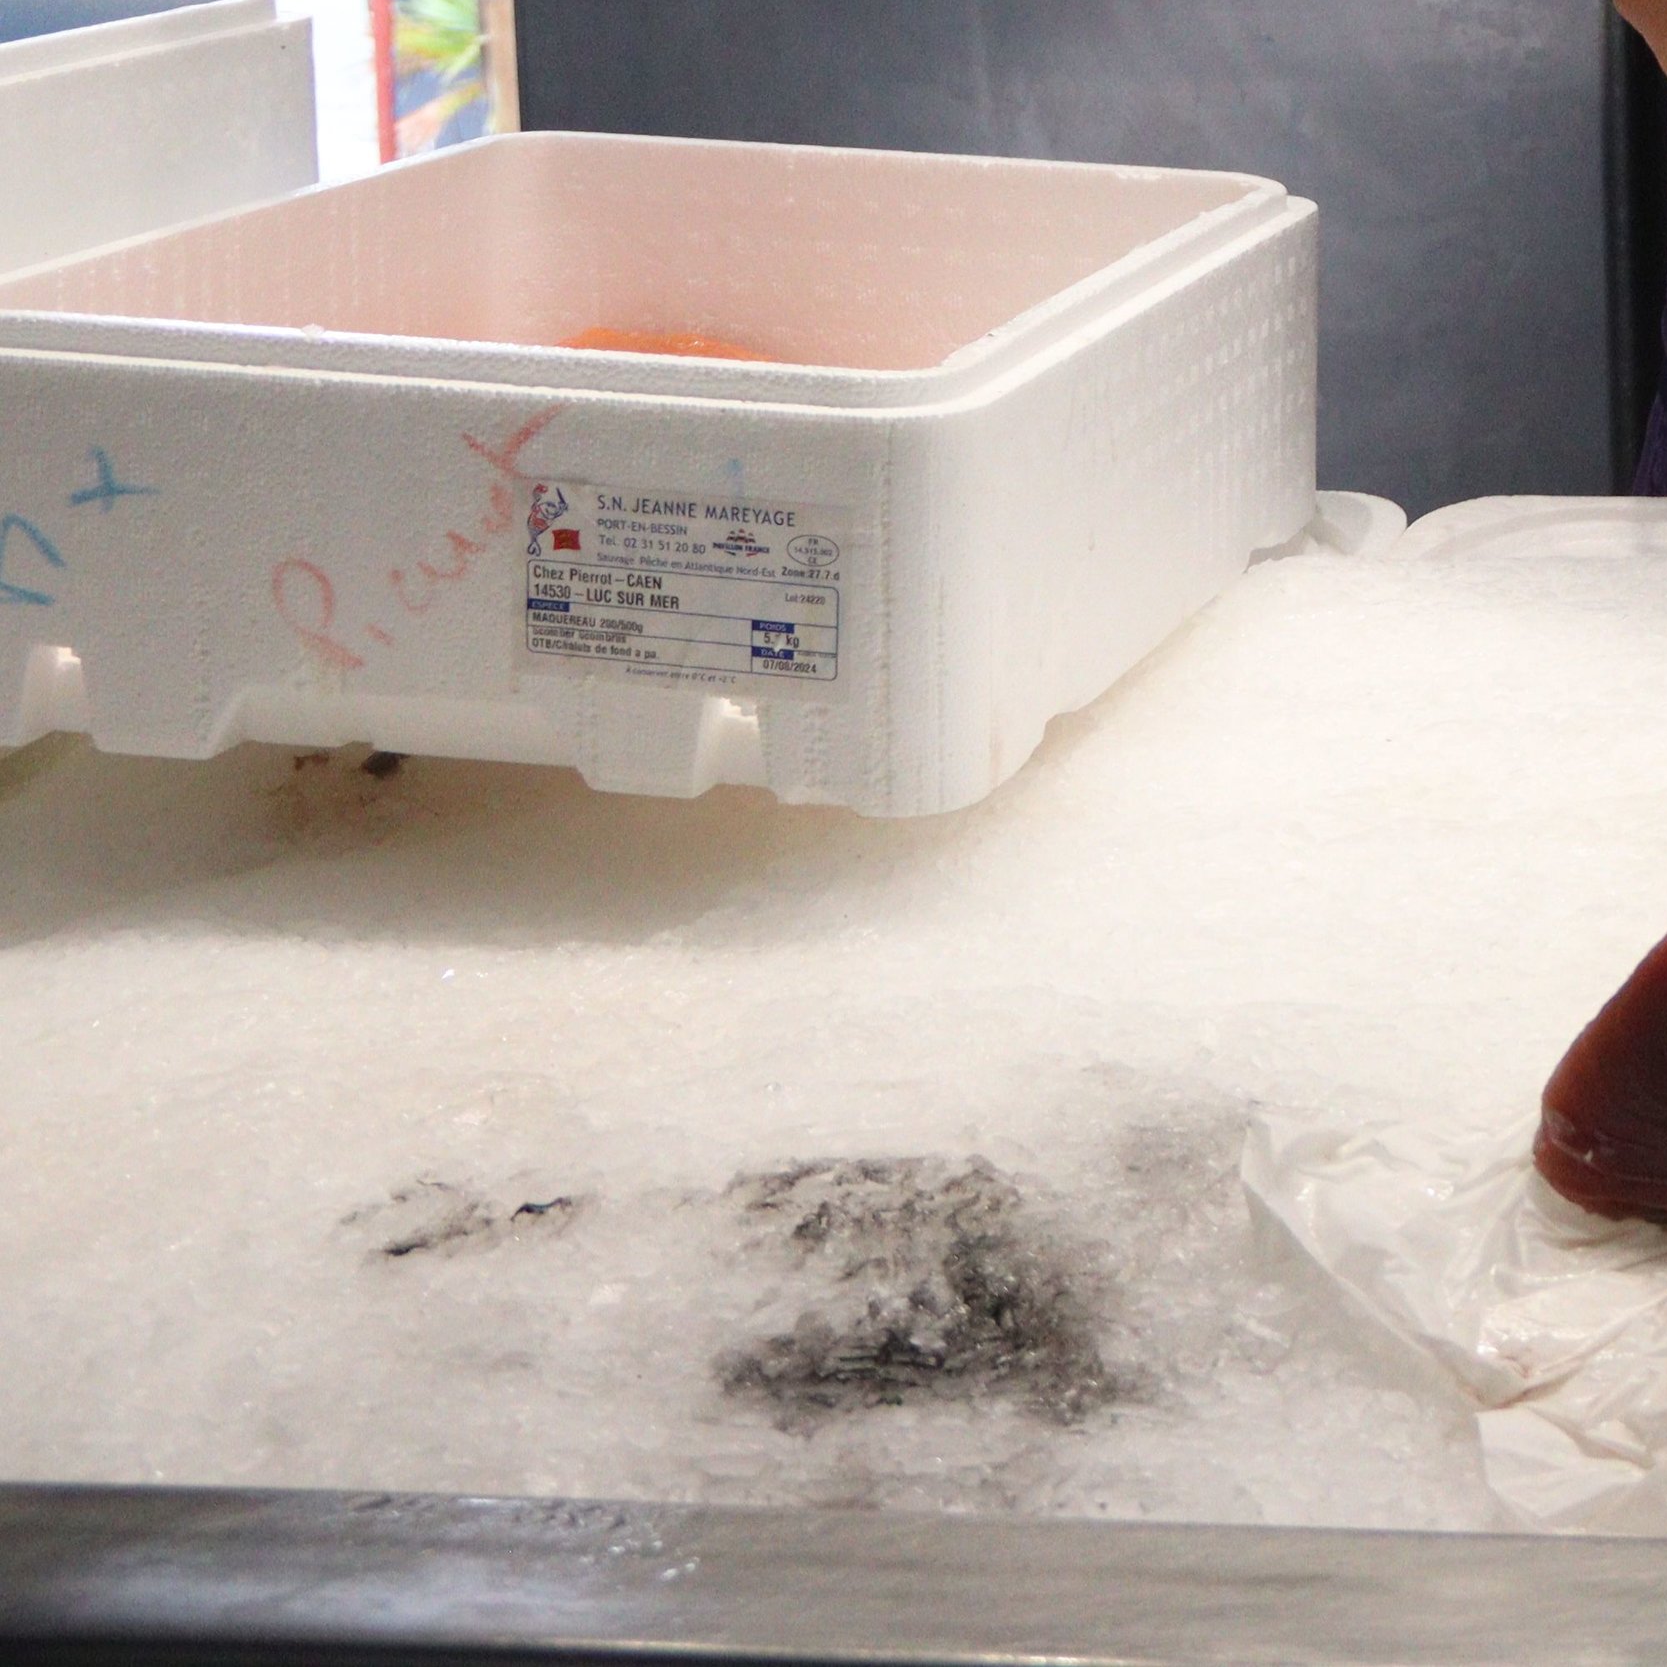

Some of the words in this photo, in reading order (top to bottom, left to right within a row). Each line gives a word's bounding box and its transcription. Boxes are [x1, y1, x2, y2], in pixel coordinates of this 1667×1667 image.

[597, 495, 627, 512] S.N.
[632, 498, 697, 518] JEANNE
[705, 505, 796, 527] MAREYAGE
[597, 518, 688, 536] PORT-EN-BESSIN
[624, 537, 637, 549] 02
[641, 539, 653, 550] 31
[658, 540, 671, 551] 51
[675, 542, 689, 553] 20
[692, 544, 706, 555] 80
[684, 560, 734, 575] Atlantique
[533, 565, 564, 581] Chez
[569, 568, 612, 585] Pierrot
[626, 573, 663, 590] CAEN
[534, 583, 571, 599] 14530
[586, 588, 612, 604] LUC
[617, 591, 644, 607] SUR
[650, 594, 680, 610] MER
[532, 612, 596, 628] MAQUEREAU
[595, 643, 608, 653] de
